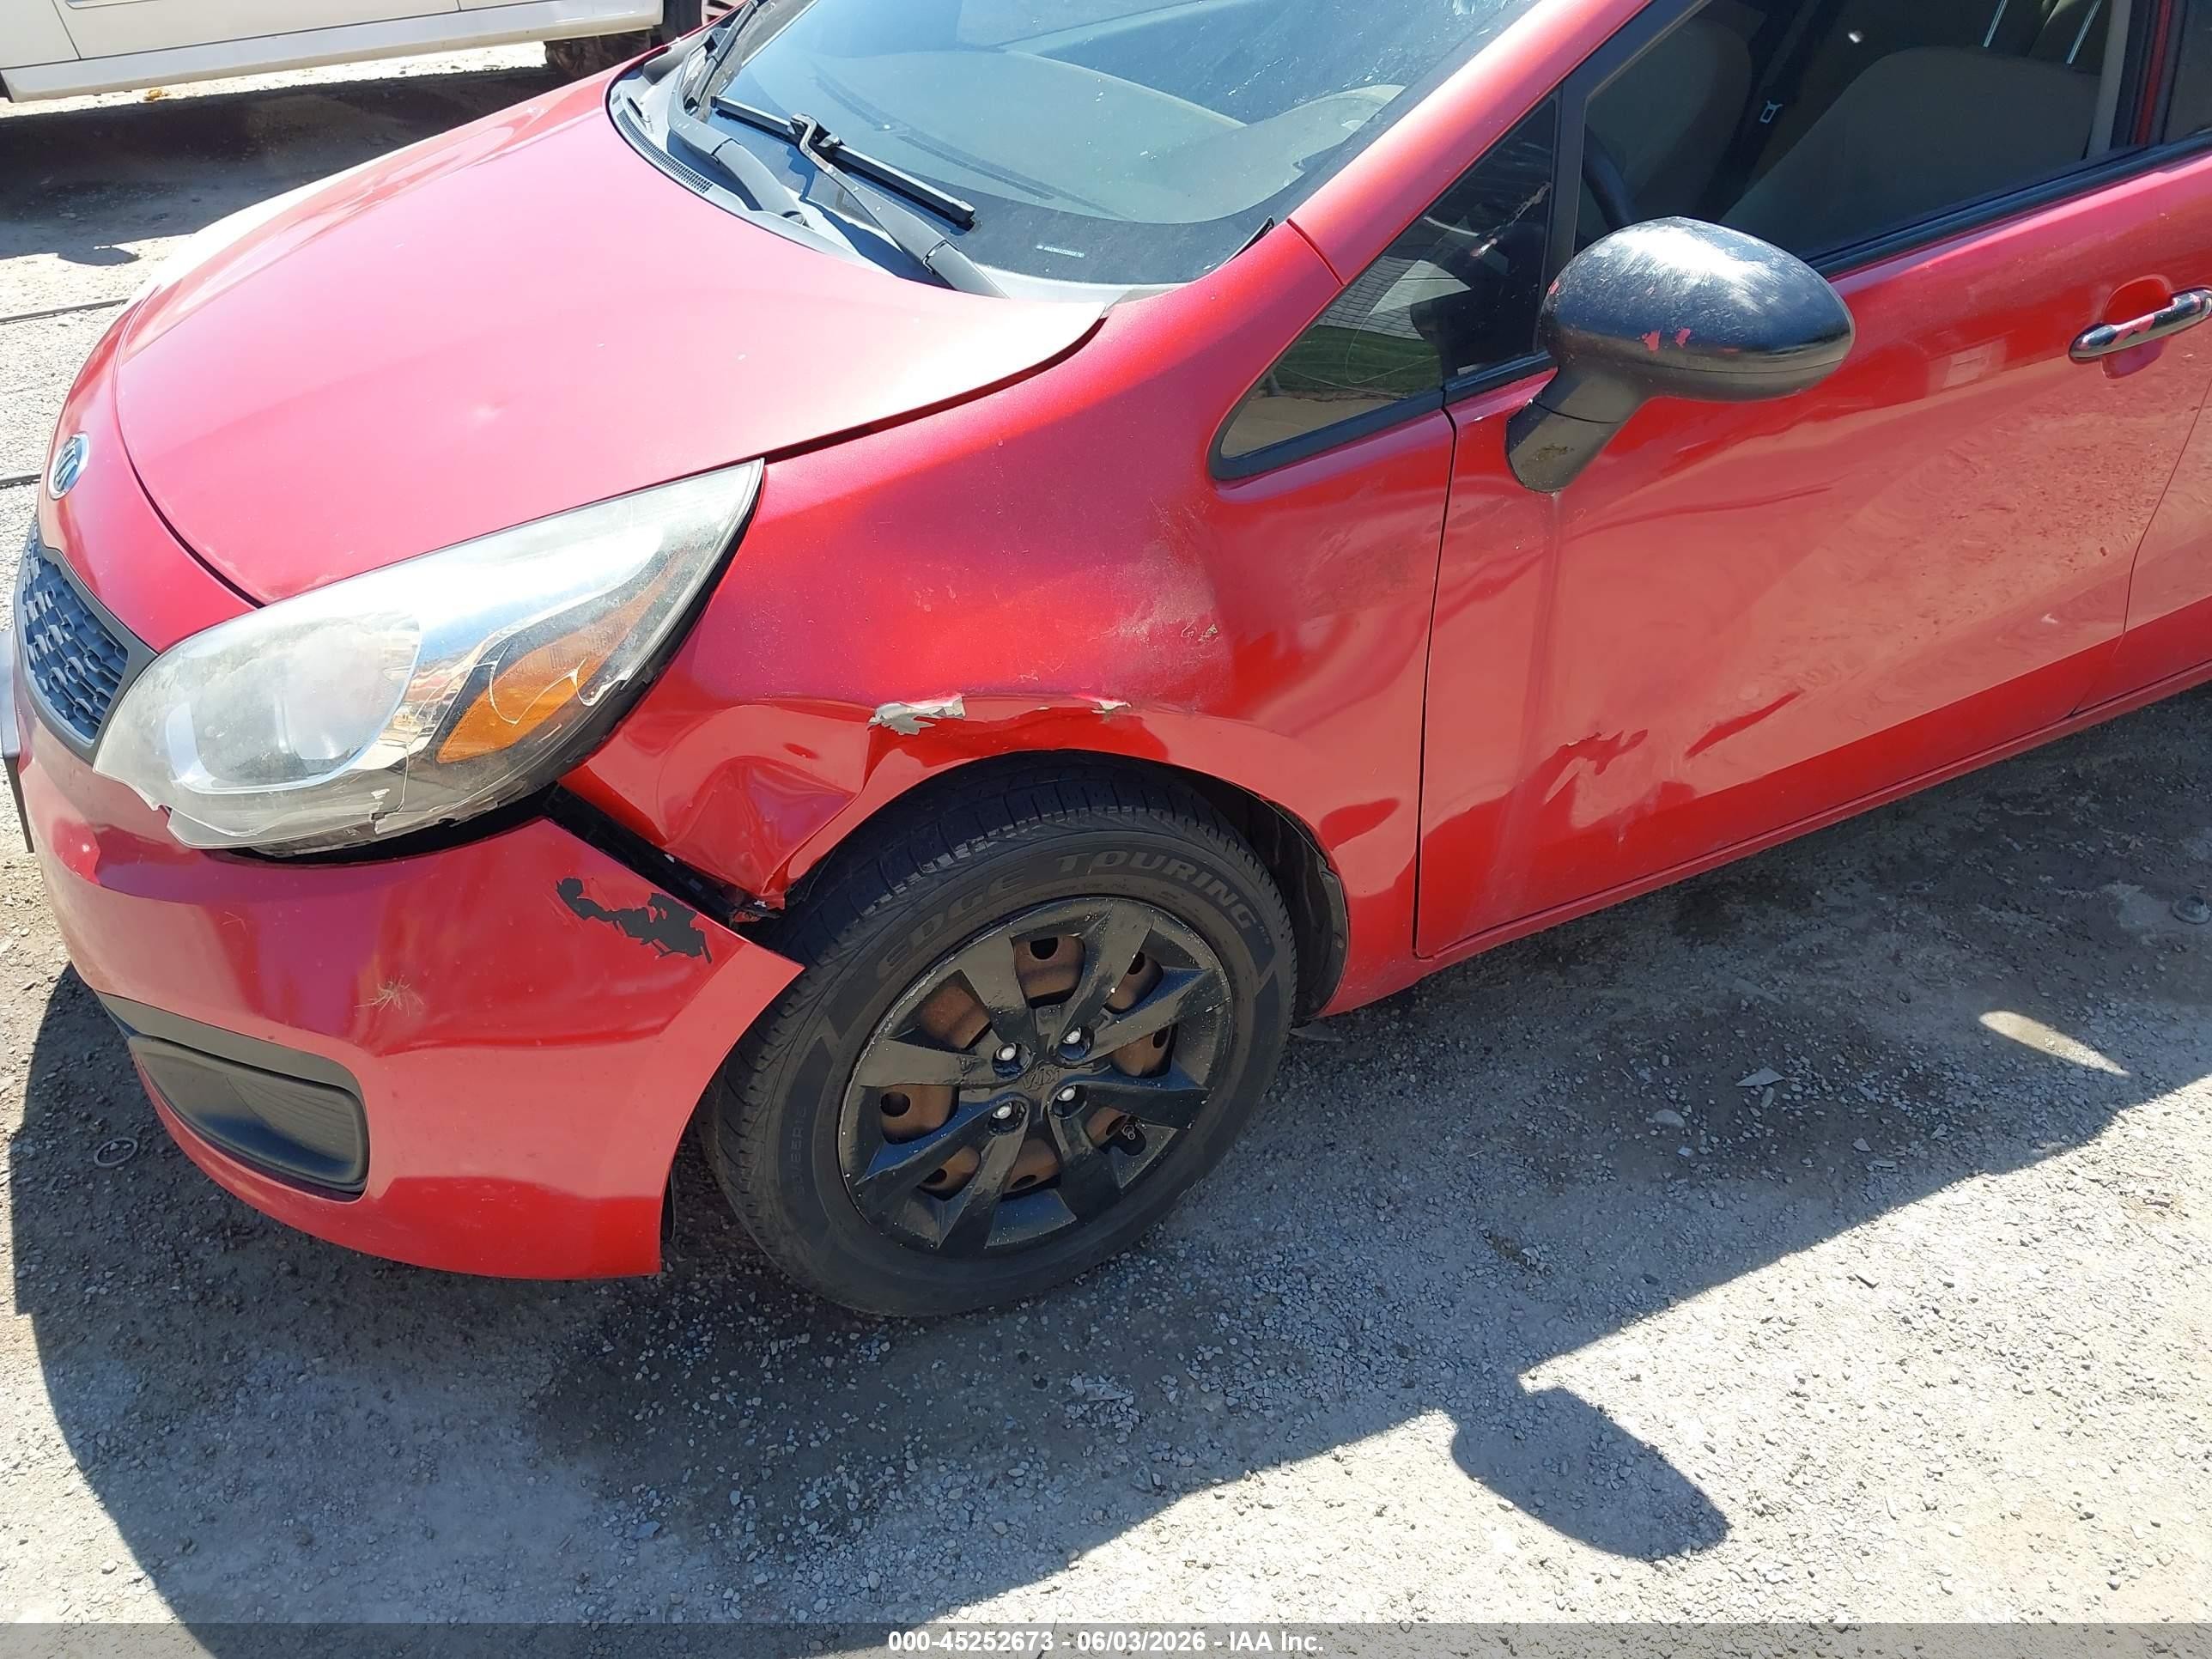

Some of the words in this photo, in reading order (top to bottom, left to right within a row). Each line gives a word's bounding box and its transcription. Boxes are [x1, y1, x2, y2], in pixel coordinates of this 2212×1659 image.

[876, 866, 1026, 978] EDGE
[1055, 850, 1257, 929] TOURING
[1023, 1066, 1060, 1090] KIA
